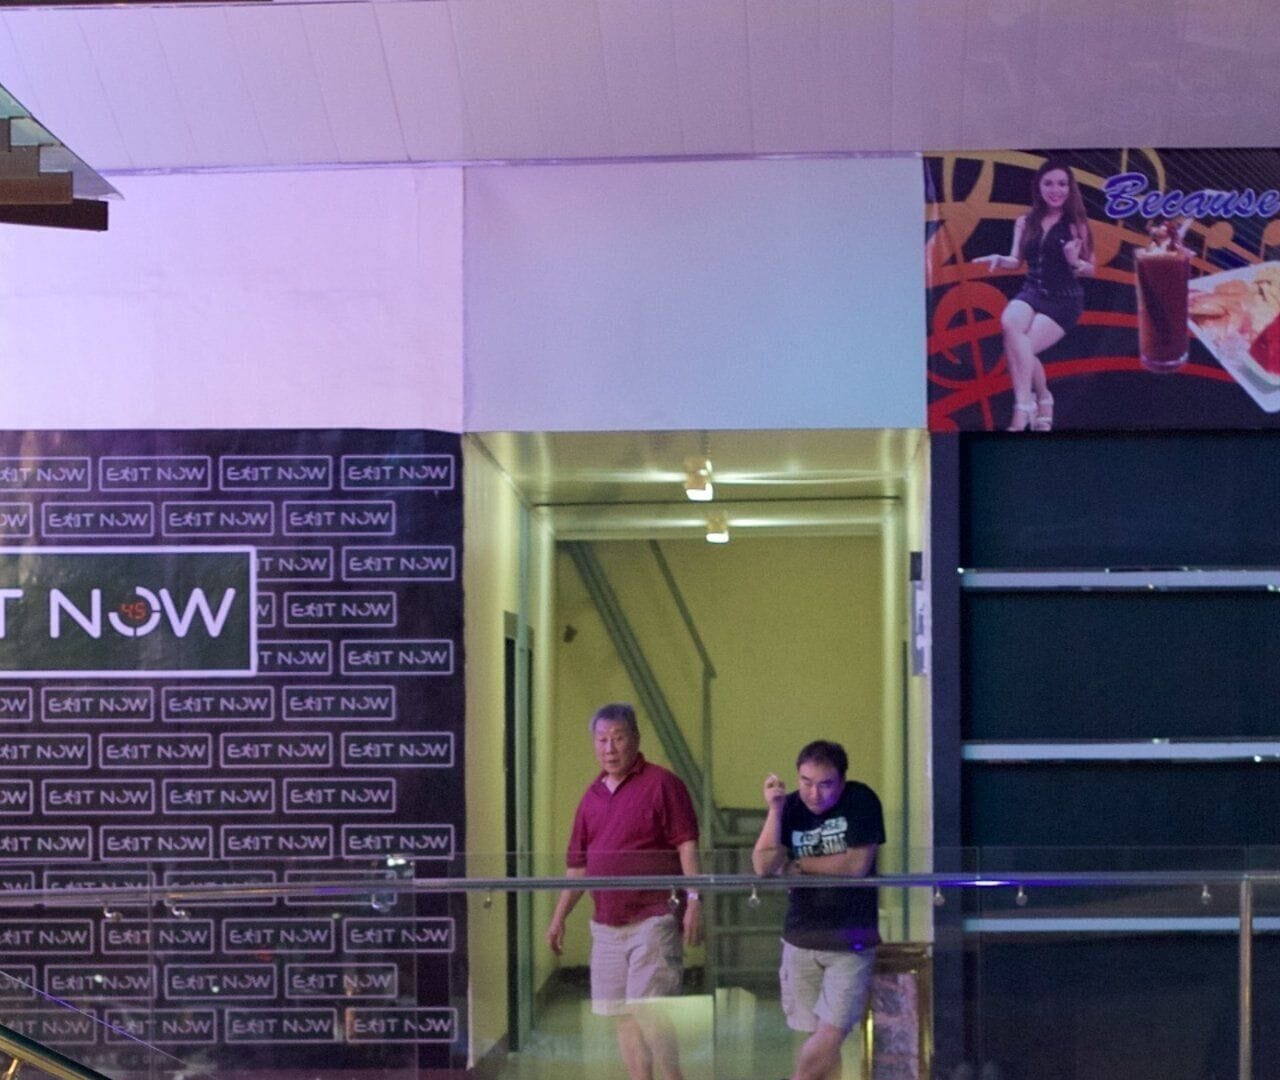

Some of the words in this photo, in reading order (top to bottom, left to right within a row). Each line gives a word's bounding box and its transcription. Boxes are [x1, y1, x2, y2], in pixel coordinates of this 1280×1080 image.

[36, 468, 85, 482] NOW
[157, 467, 206, 482] NOW
[278, 466, 327, 481] NOW
[398, 466, 448, 480] NOW
[99, 513, 148, 528] NOW
[220, 512, 269, 527] NOW
[340, 511, 390, 526] NOW
[279, 557, 328, 572] NOW
[400, 556, 449, 572] NOW
[49, 586, 237, 640] NOW
[342, 602, 391, 617] NOW
[277, 651, 326, 666] NOW
[398, 650, 447, 666] NOW
[99, 697, 148, 712] NOW
[219, 697, 268, 712] NOW
[340, 696, 389, 711] NOW
[37, 744, 86, 759] NOW
[157, 744, 206, 759] NOW
[278, 743, 327, 758] NOW
[399, 743, 448, 758] NOW
[100, 790, 149, 805] NOW
[220, 789, 269, 804] NOW
[341, 789, 390, 804] NOW
[37, 837, 86, 852] NOW
[158, 836, 207, 851] NOW
[279, 836, 328, 851] NOW
[400, 836, 449, 850] NOW
[38, 930, 87, 945] NOW
[159, 929, 208, 944] NOW
[280, 929, 329, 944] NOW
[401, 929, 450, 944] NOW
[102, 975, 151, 990] NOW
[222, 974, 271, 989] NOW
[343, 974, 392, 989] NOW
